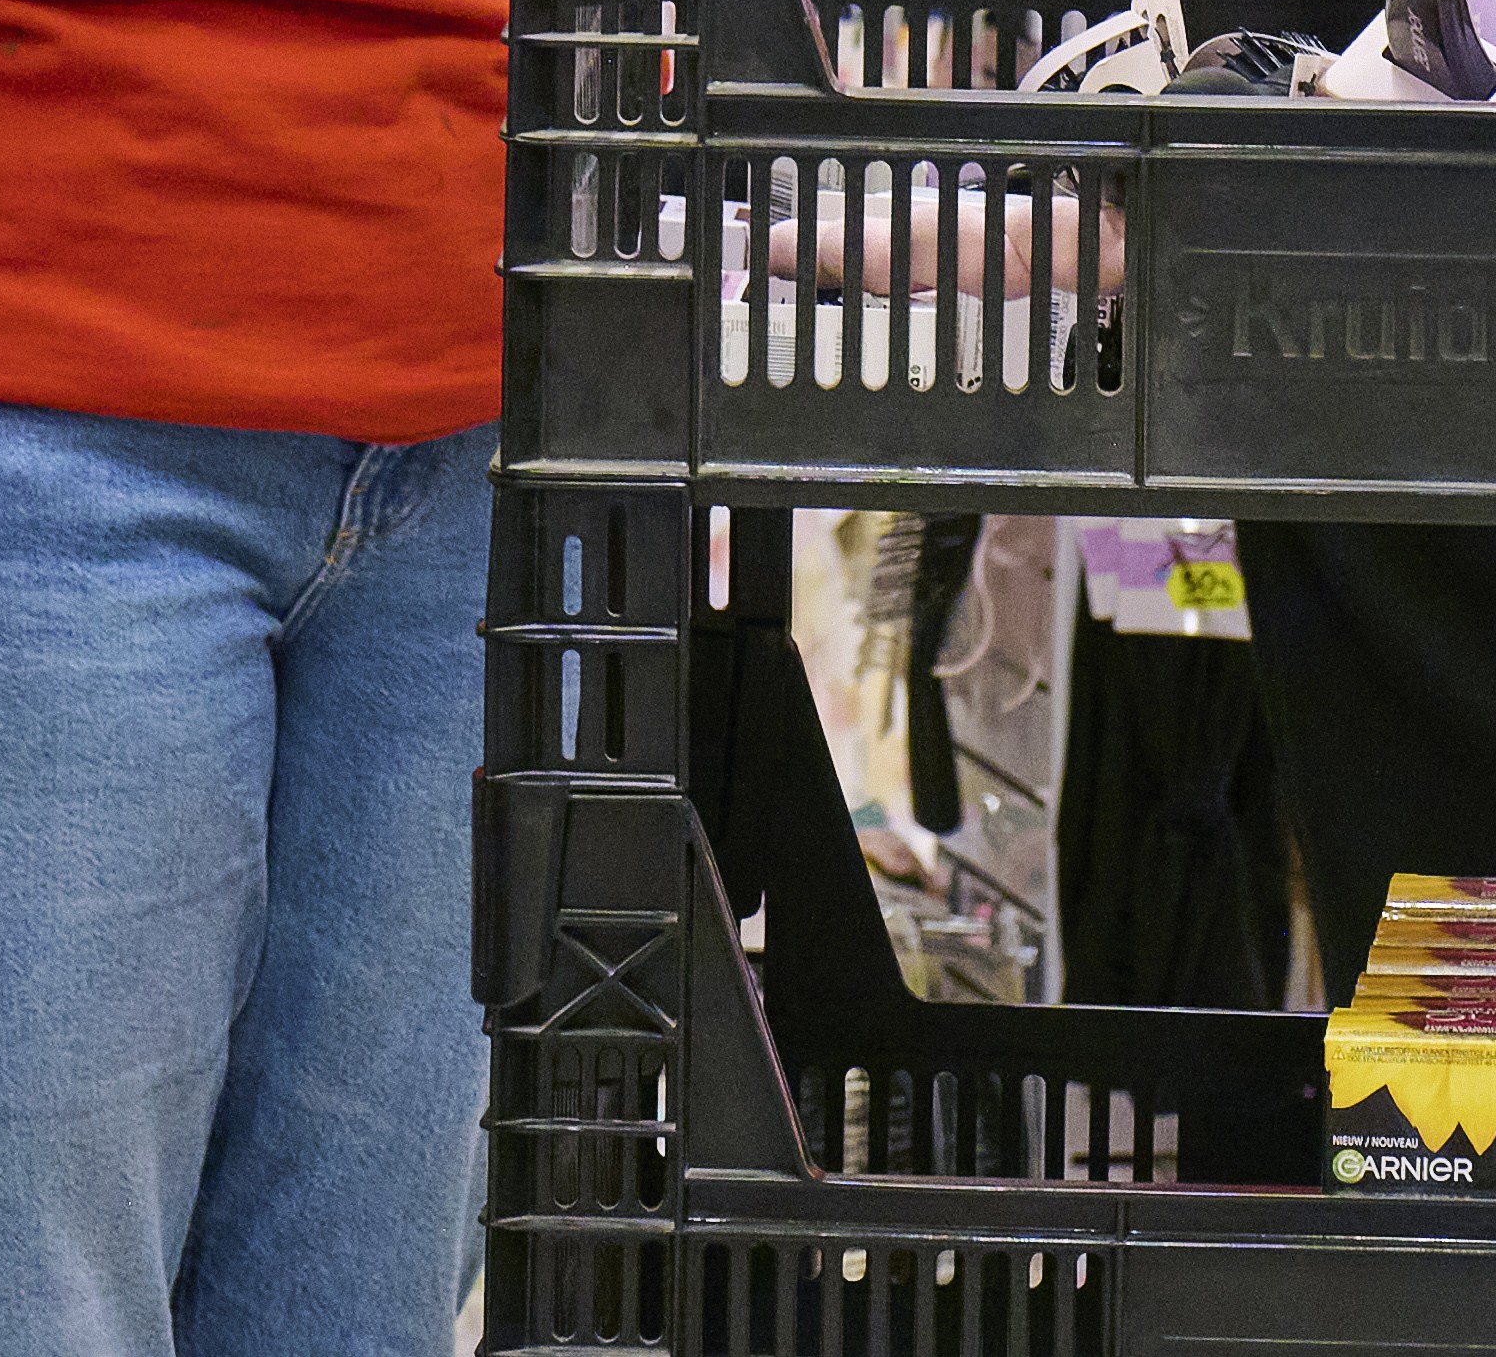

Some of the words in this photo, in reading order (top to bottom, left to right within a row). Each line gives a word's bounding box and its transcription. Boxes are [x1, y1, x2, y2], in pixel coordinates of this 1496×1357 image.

[1332, 1135, 1363, 1147] NIEUW
[1371, 1136, 1419, 1150] NOUVEAU
[1337, 1154, 1474, 1183] GARNIER
